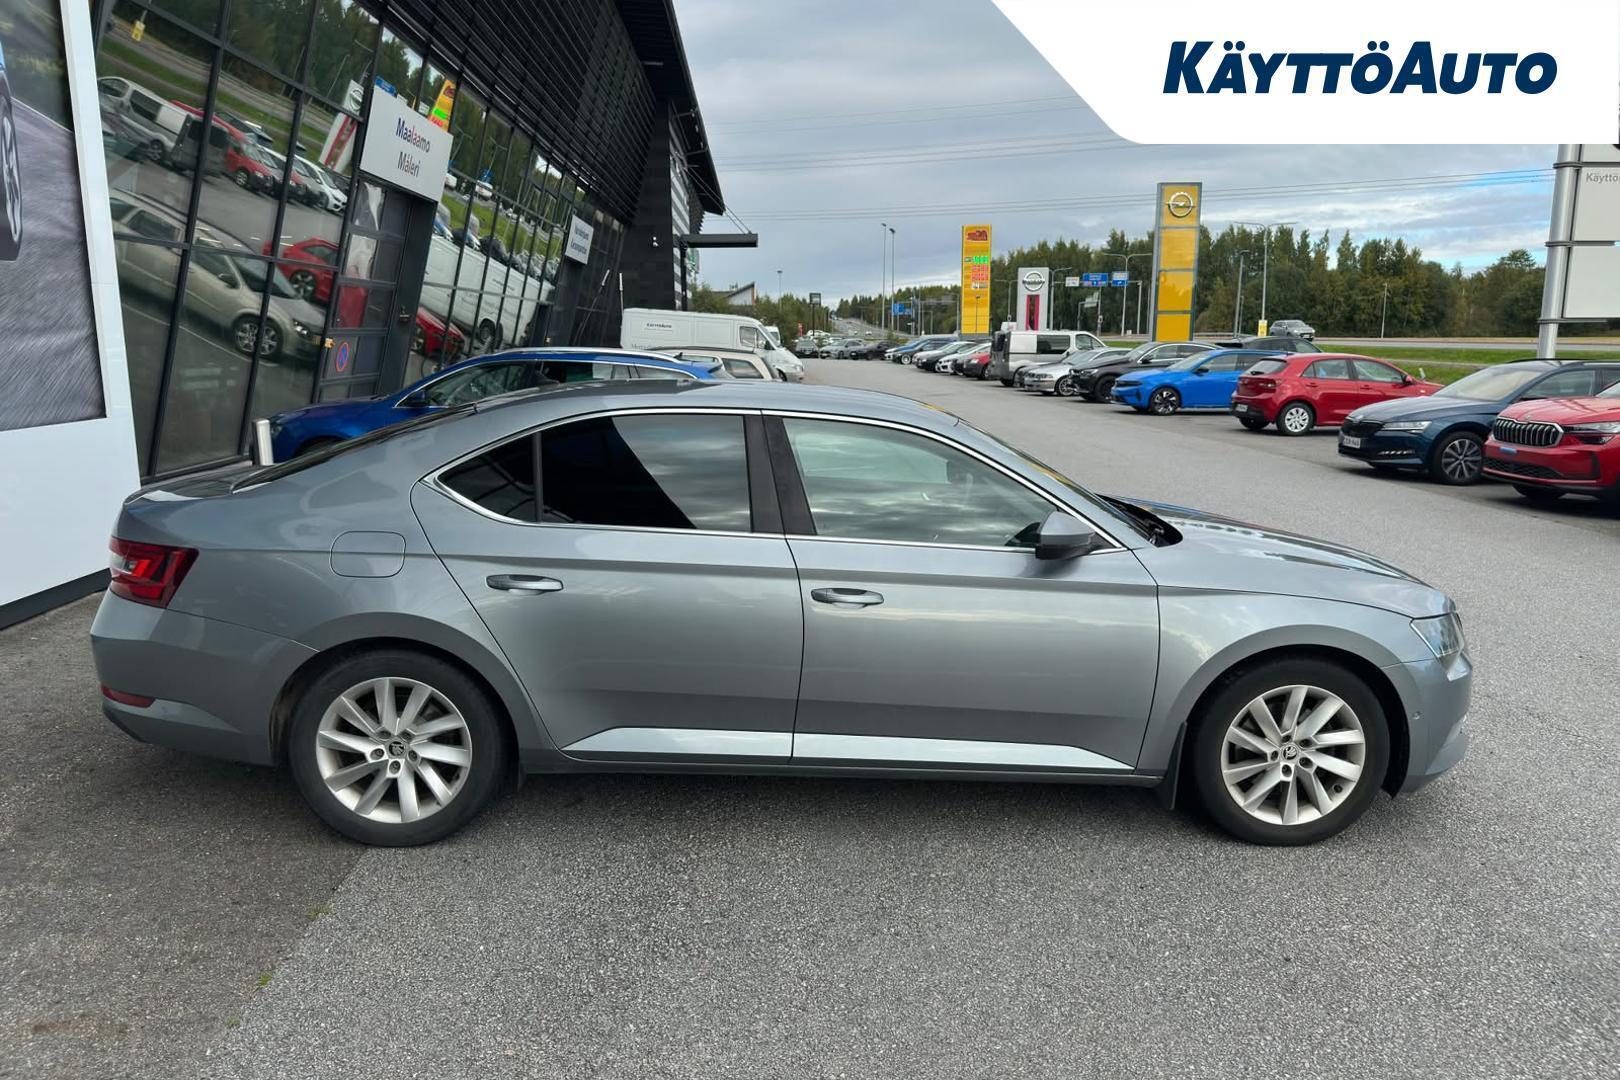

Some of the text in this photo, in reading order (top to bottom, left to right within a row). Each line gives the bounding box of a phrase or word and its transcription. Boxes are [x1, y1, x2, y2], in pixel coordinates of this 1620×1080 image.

[396, 117, 430, 153] Maalaamo
[397, 151, 421, 178] Måleri
[1586, 172, 1620, 184] Käyttö
